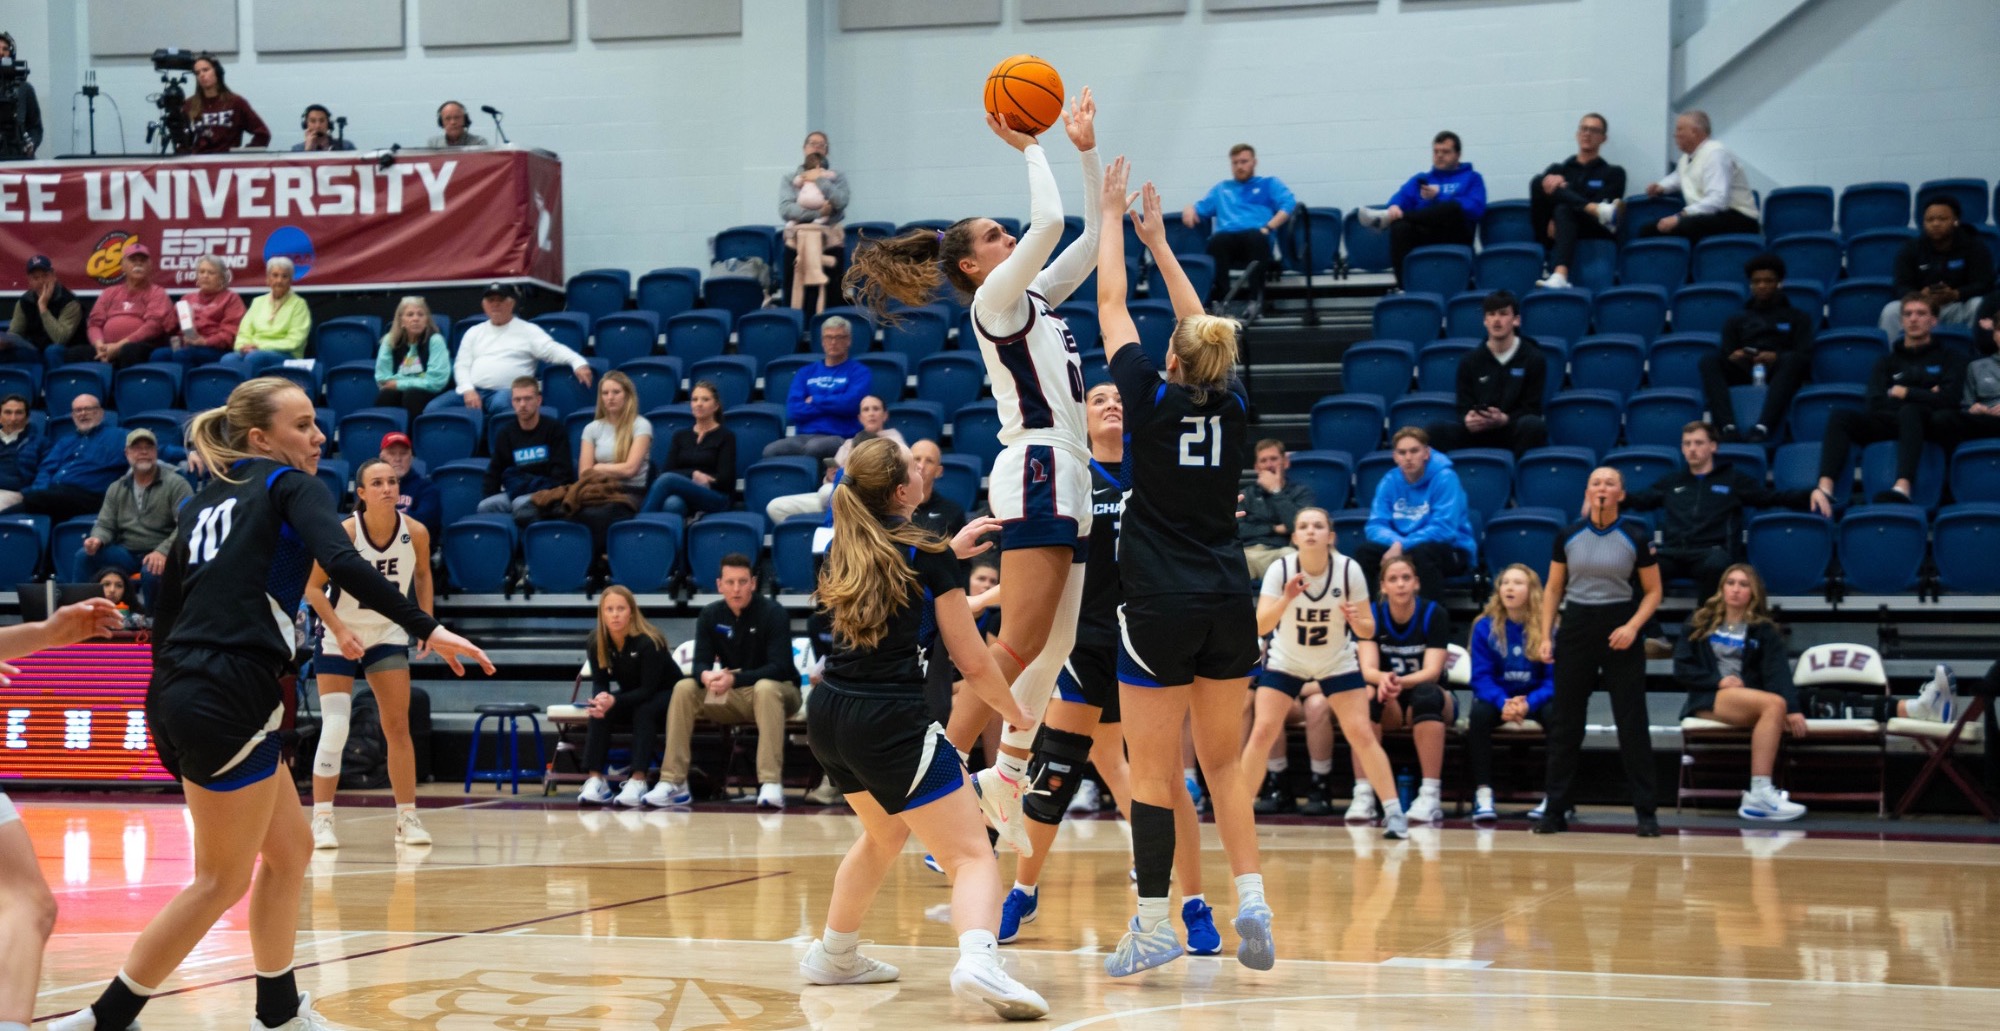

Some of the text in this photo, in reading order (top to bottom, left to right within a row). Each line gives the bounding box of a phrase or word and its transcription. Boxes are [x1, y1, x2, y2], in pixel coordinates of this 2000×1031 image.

[83, 161, 458, 221] UNIVERSITY
[161, 227, 251, 255] ESPN
[160, 255, 249, 269] CLEVND
[1179, 415, 1222, 466] 21
[188, 497, 237, 564] 10
[374, 558, 399, 576] EE
[1296, 608, 1331, 622] LEE
[1296, 626, 1328, 646] 12
[1808, 650, 1871, 671] LEE
